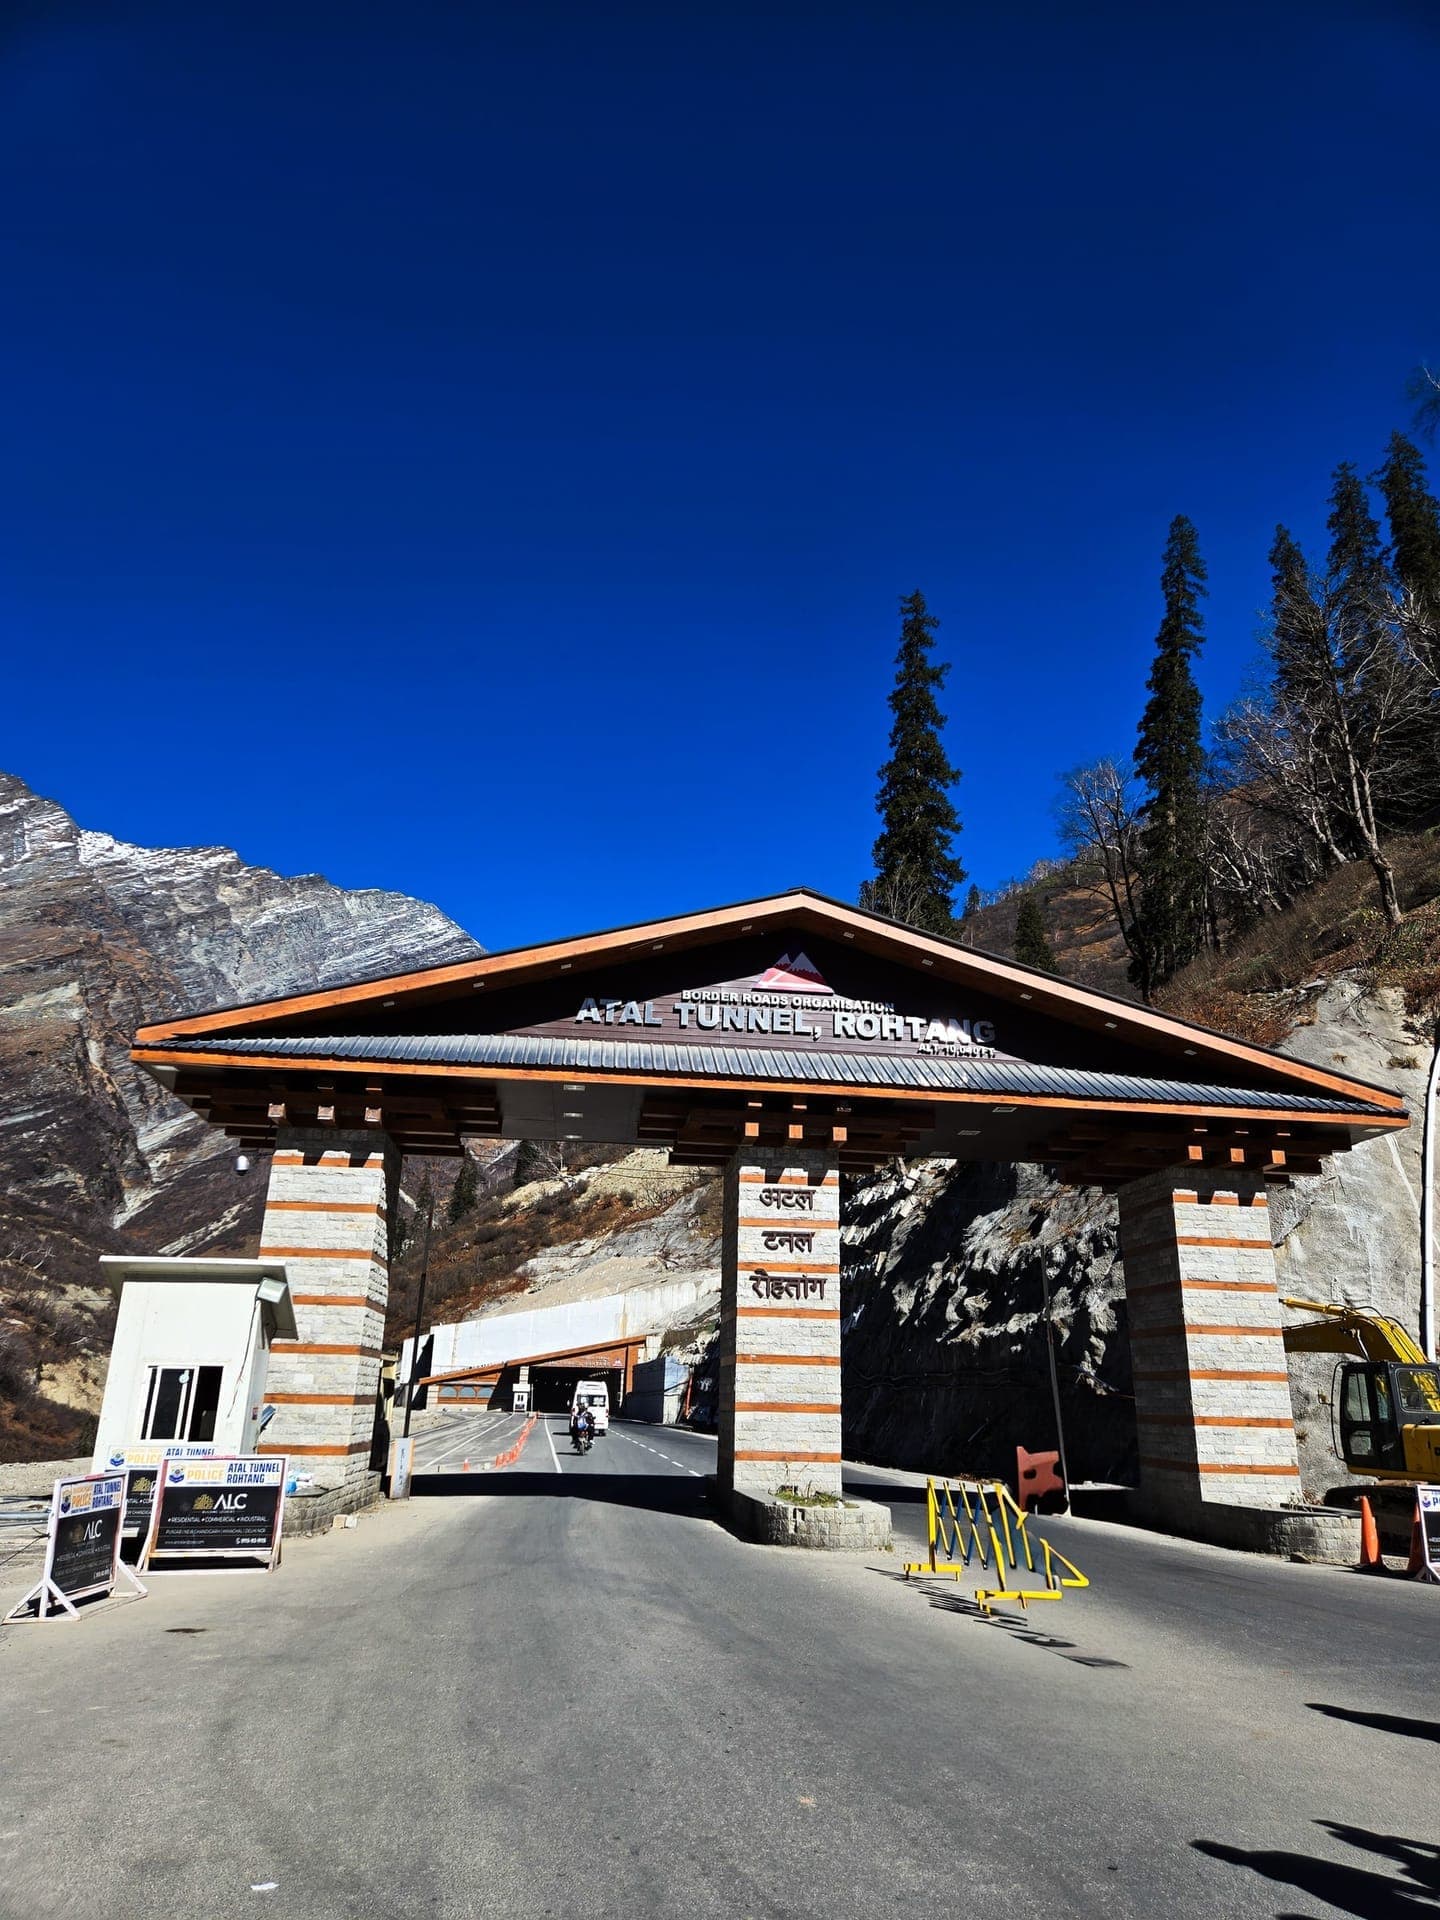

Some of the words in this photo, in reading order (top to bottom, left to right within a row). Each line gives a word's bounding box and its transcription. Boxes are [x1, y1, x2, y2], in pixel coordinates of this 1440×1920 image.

[681, 989, 739, 1004] BORDER
[741, 993, 789, 1008] ROADS
[792, 995, 895, 1014] ORGANISATION
[575, 996, 663, 1027] ATAL
[673, 1002, 823, 1042] TUNNEL,
[833, 1011, 997, 1045] ROHTANG
[759, 1187, 817, 1211] अटल
[761, 1230, 816, 1254] टनल
[749, 1268, 828, 1300] रोहतांग
[187, 1469, 224, 1481] POLICE
[227, 1473, 265, 1484] ROHTANG
[228, 1463, 247, 1473] ATAL
[249, 1463, 280, 1473] TUNNEL
[213, 1493, 248, 1511] ALC
[83, 1519, 103, 1541] ALC
